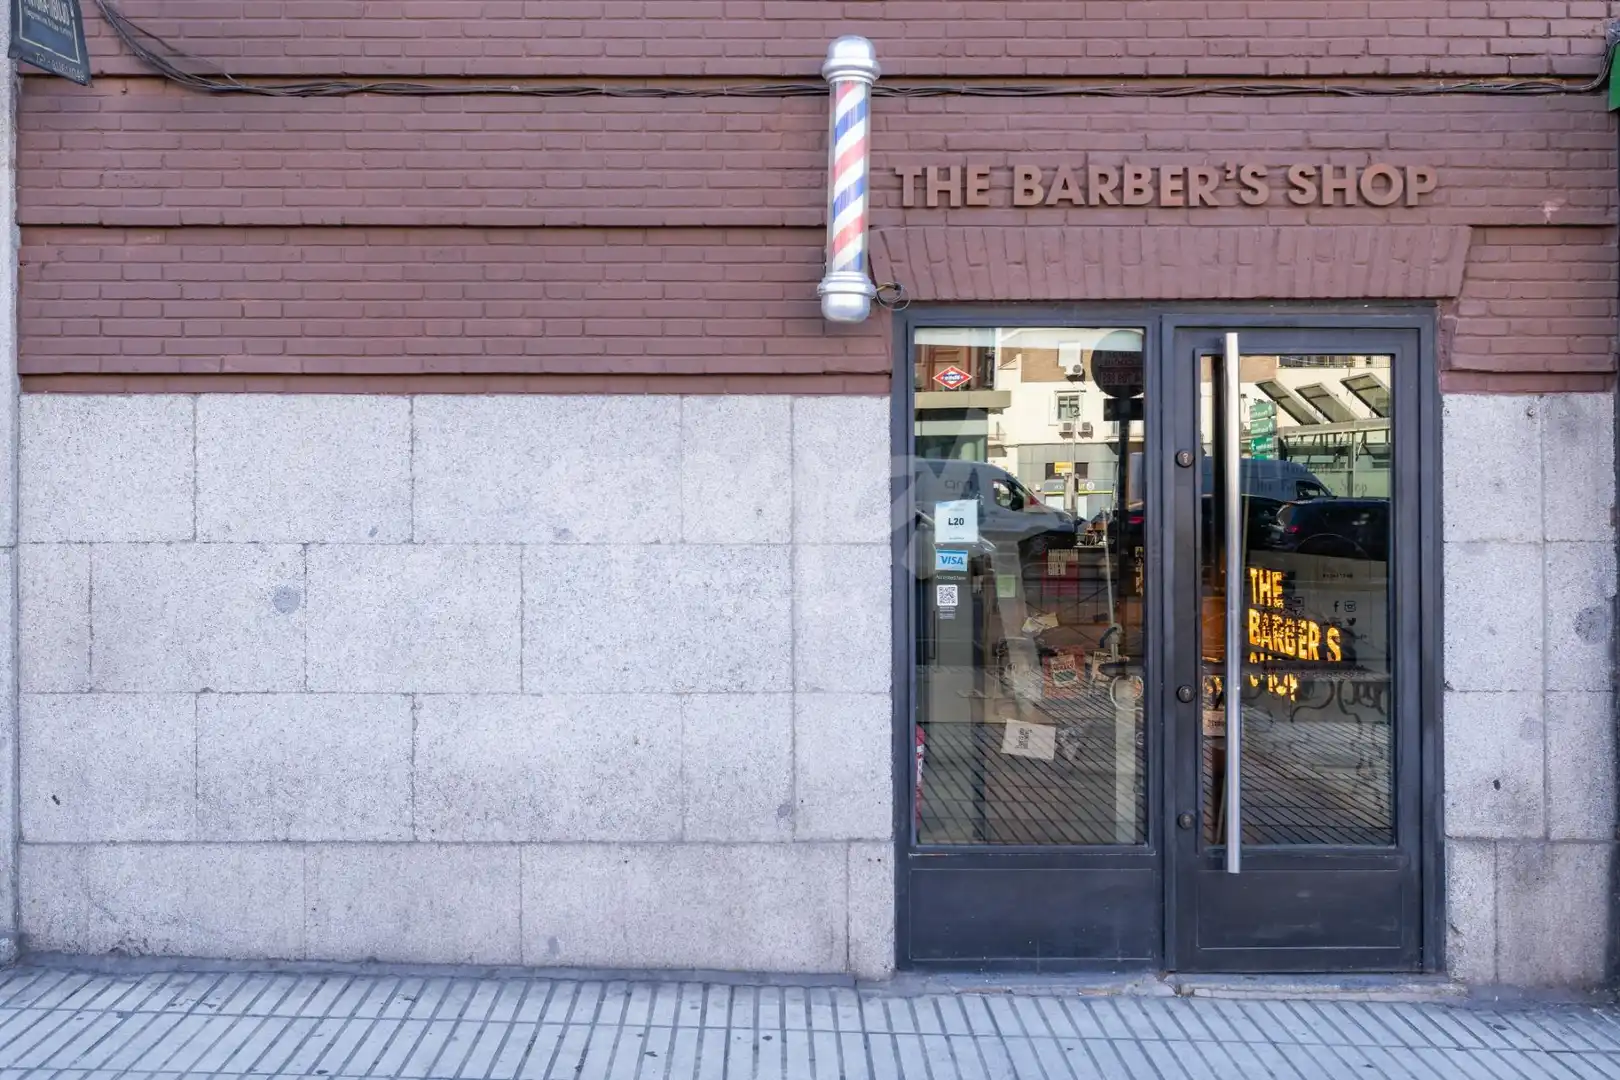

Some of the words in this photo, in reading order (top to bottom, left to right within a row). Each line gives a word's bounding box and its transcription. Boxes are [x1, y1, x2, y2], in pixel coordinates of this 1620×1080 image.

[895, 164, 990, 207] THE
[1013, 161, 1270, 207] BARBER'S
[1287, 163, 1438, 206] SHOP
[948, 517, 965, 526] L20
[940, 556, 964, 565] VISA
[1250, 567, 1284, 608] THE
